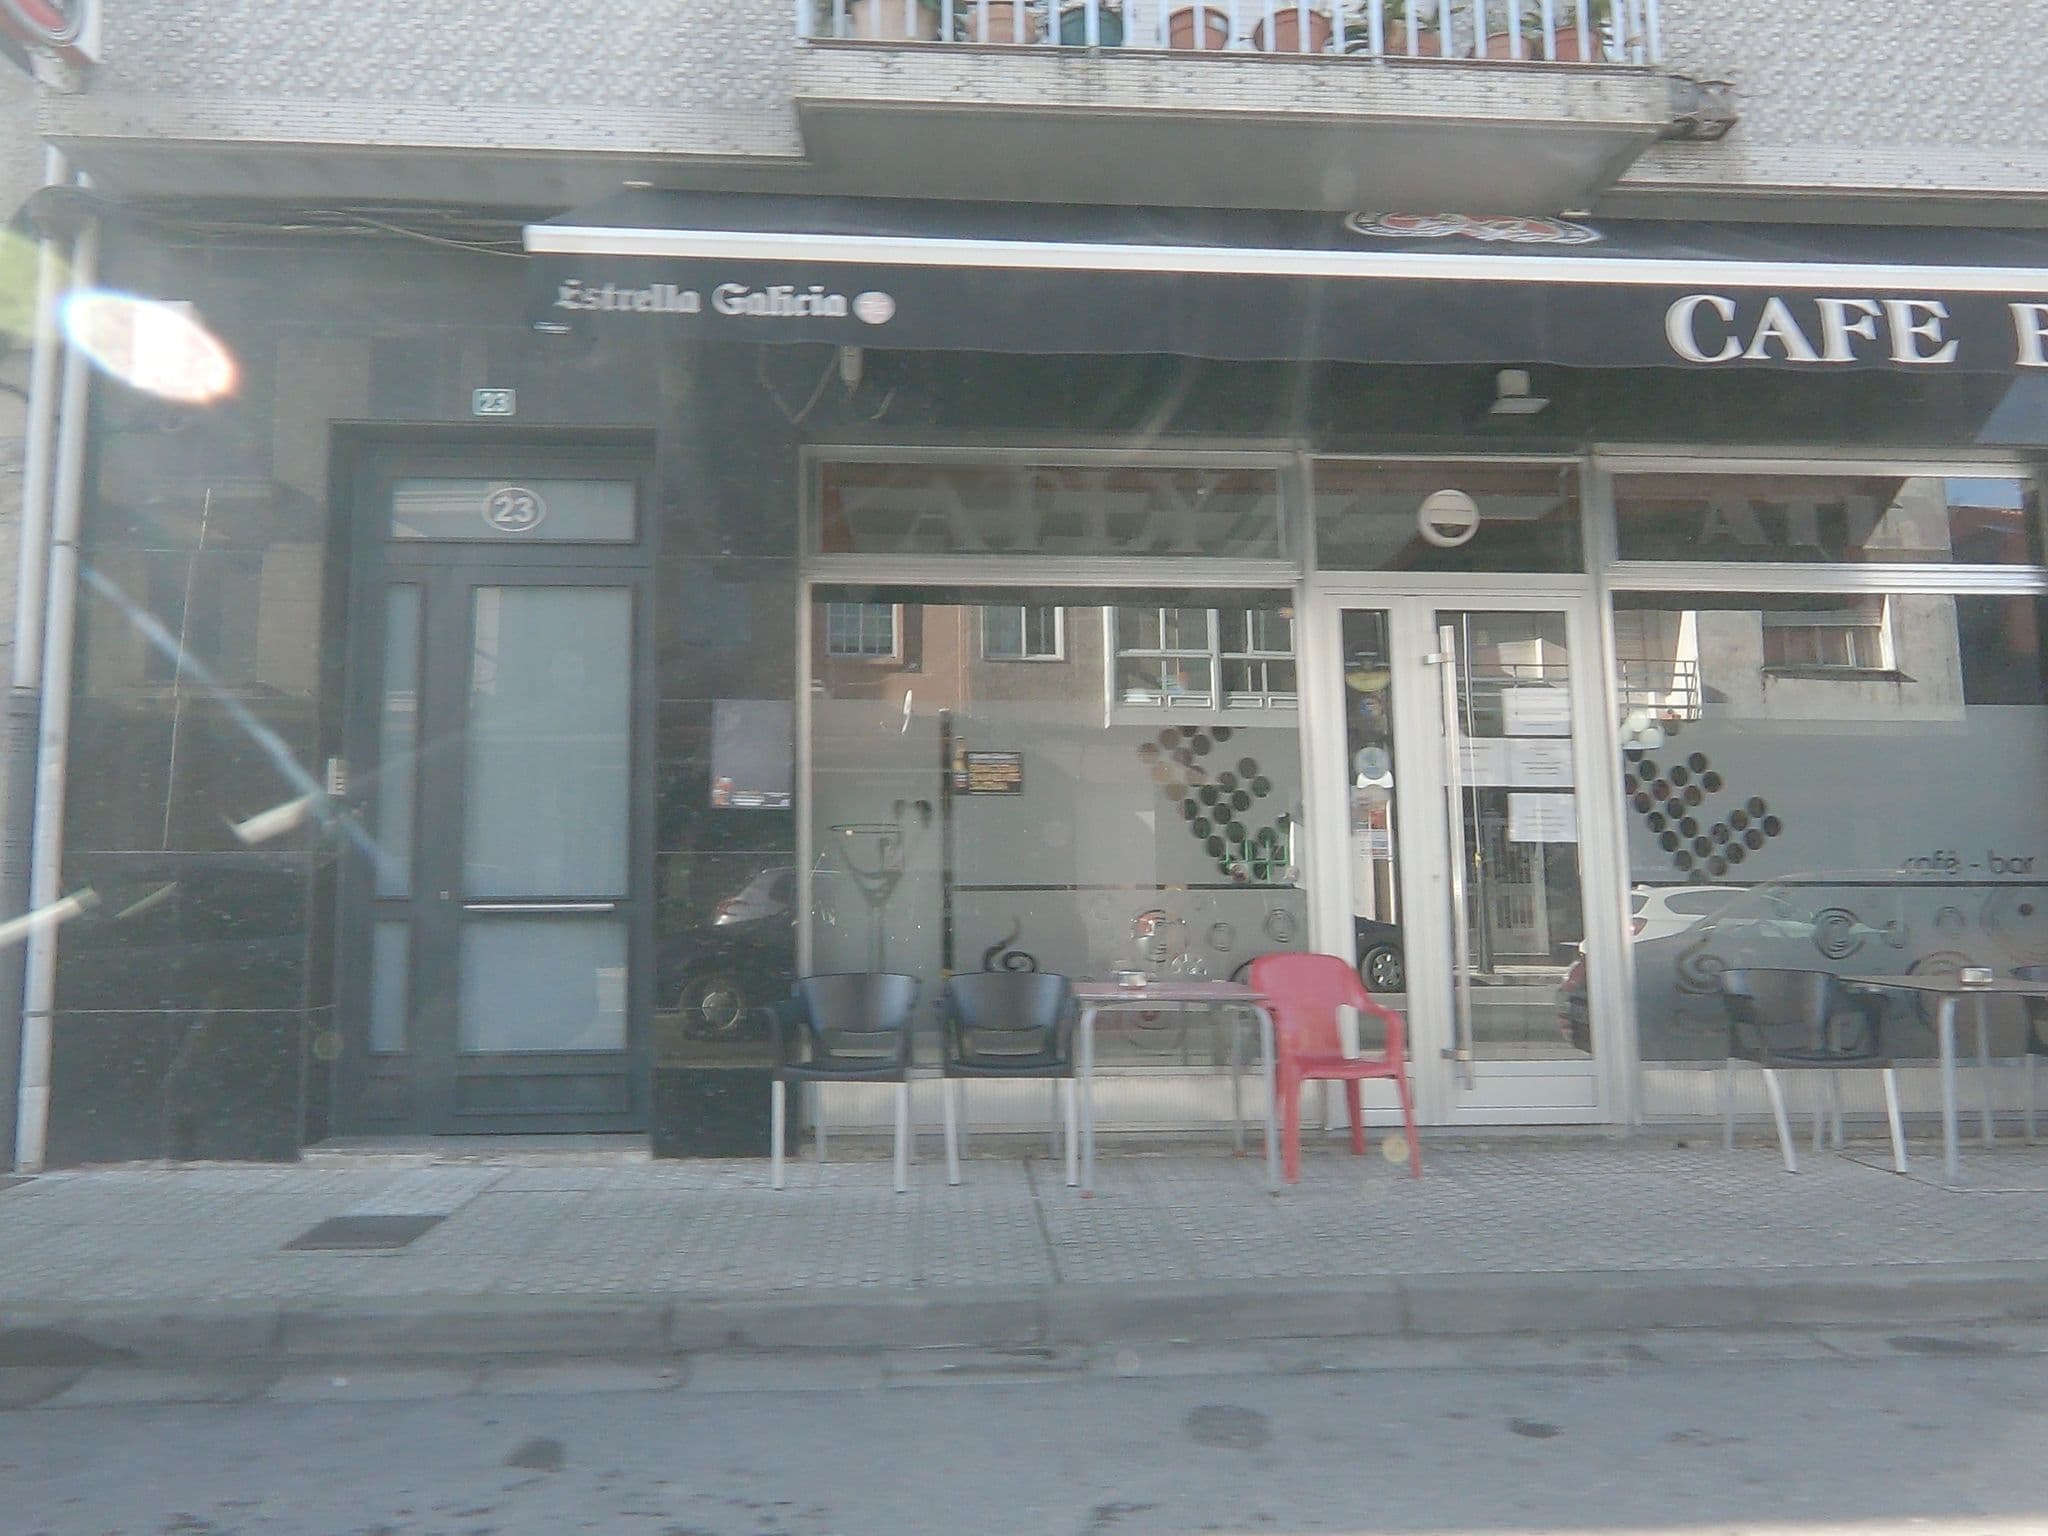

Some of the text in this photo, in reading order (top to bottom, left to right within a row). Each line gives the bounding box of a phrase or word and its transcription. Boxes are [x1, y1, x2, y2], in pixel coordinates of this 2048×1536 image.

[553, 279, 848, 316] Estrella Galicia
[1664, 294, 1959, 362] CAFE
[480, 391, 509, 412] 23
[494, 495, 536, 522] 23
[1987, 849, 2035, 875] bar
